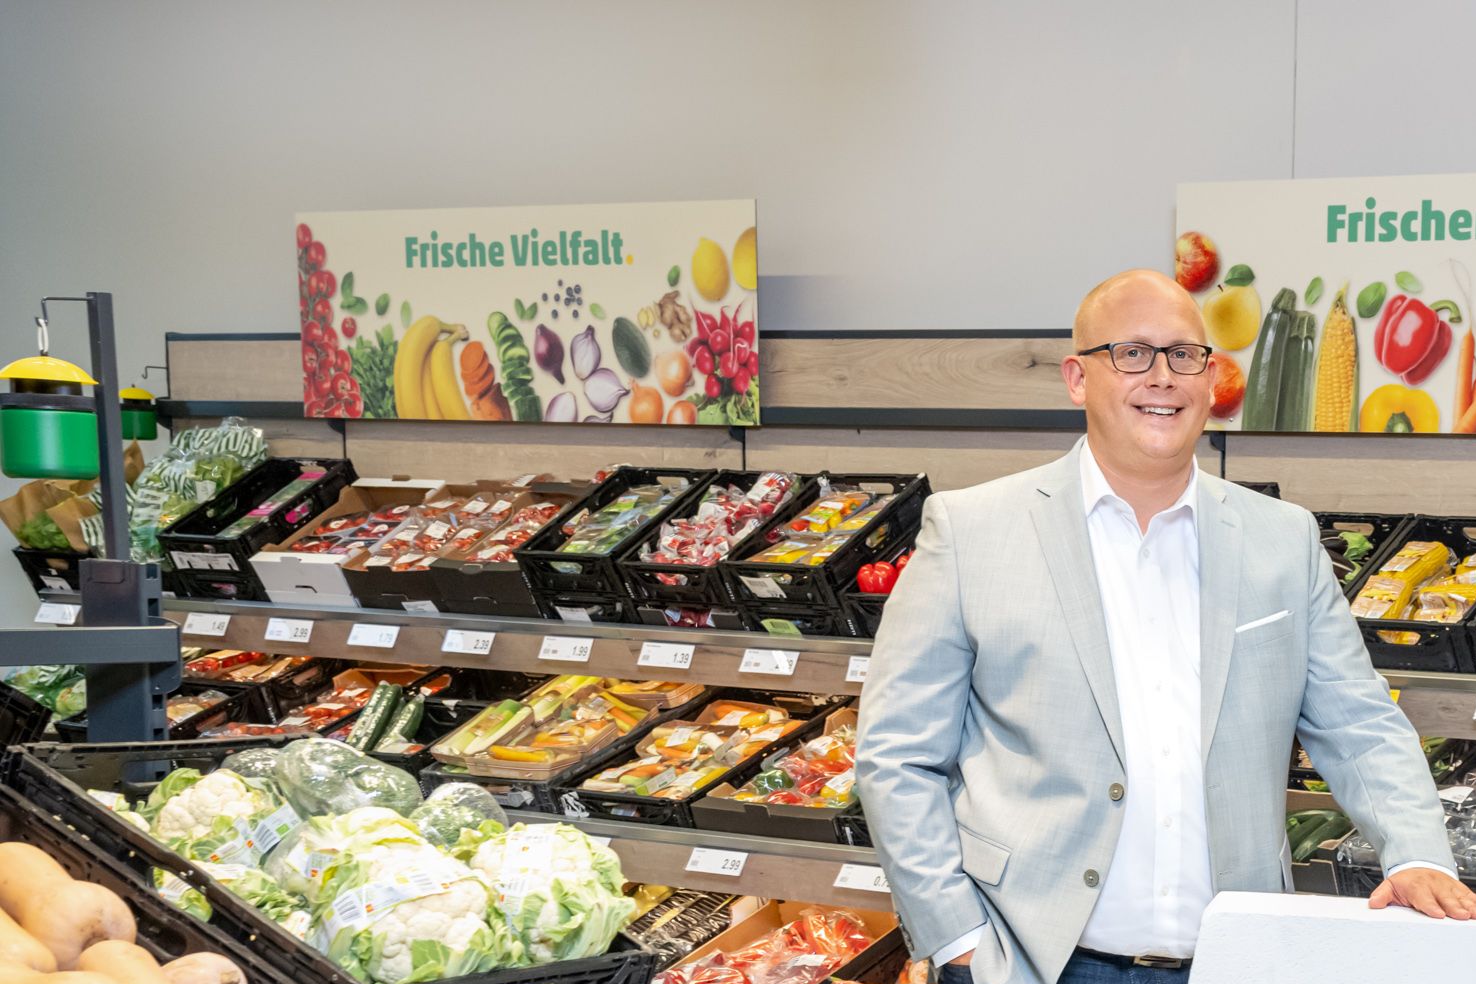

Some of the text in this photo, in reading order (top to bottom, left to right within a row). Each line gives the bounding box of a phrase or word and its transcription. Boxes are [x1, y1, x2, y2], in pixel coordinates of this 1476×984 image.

[405, 228, 634, 268] Frische Vielfalt.
[572, 645, 588, 657] 1.99
[673, 652, 690, 664] 1.39
[721, 858, 742, 871] 2.99
